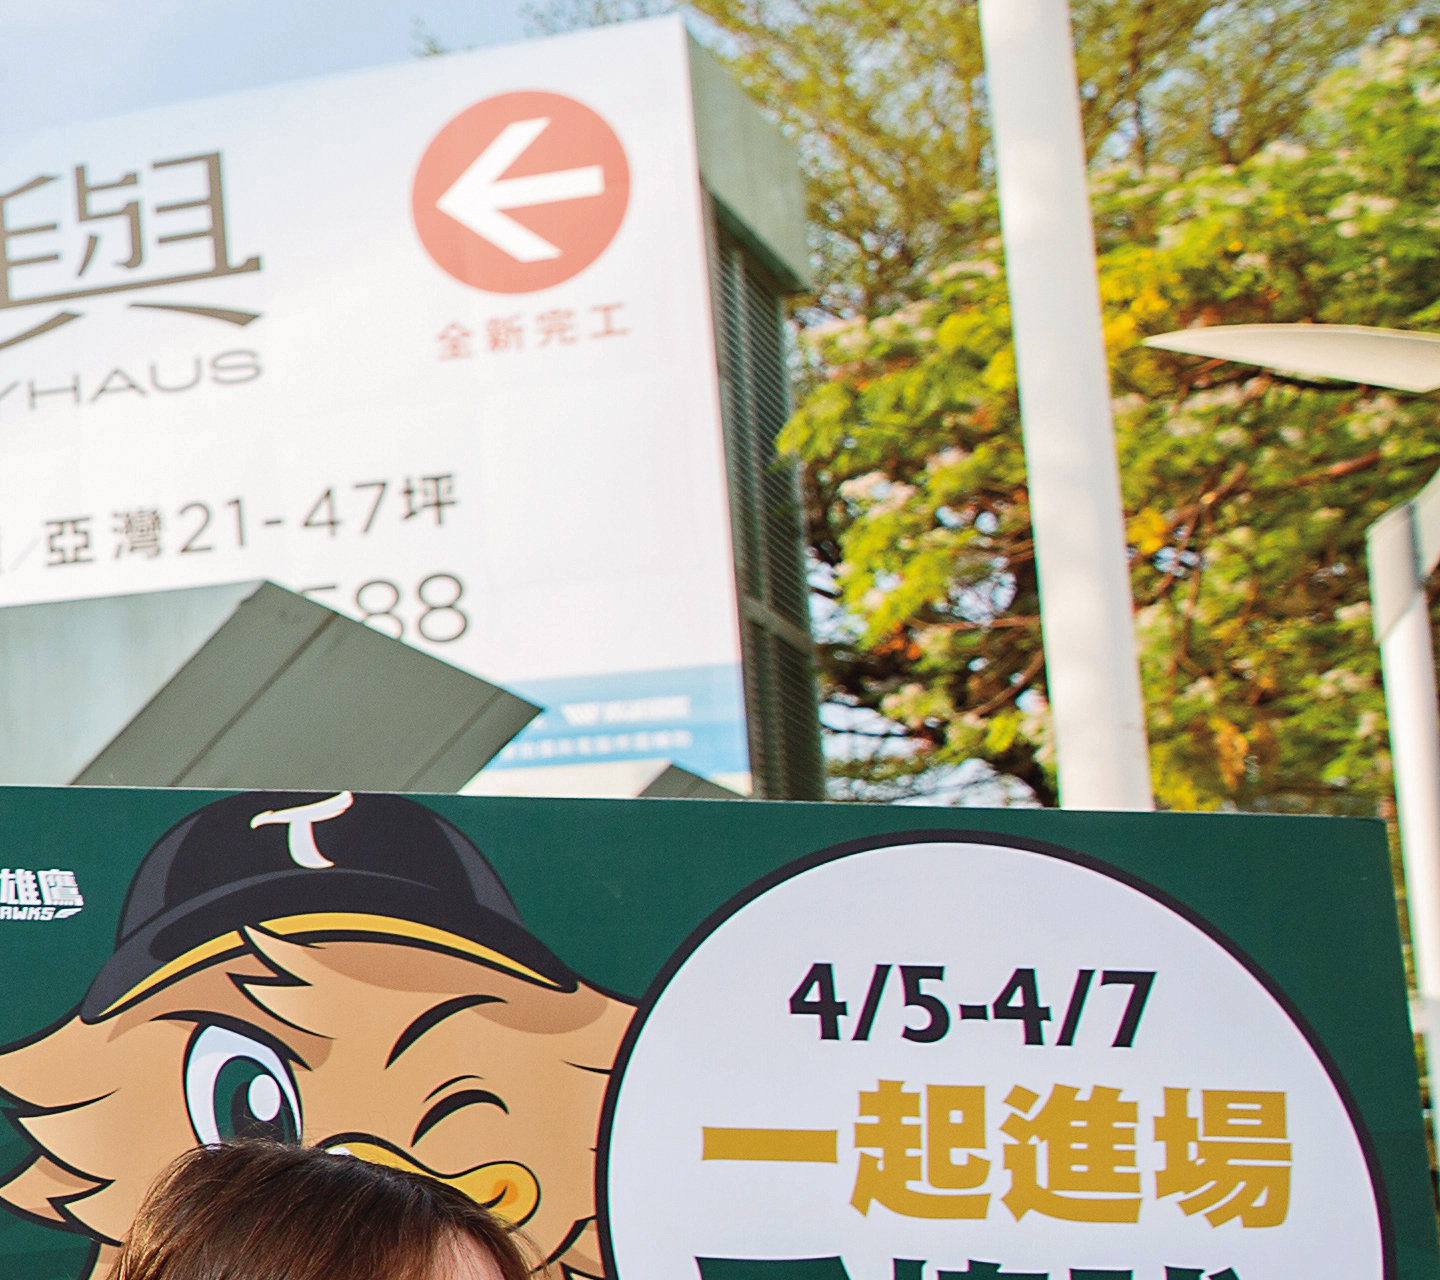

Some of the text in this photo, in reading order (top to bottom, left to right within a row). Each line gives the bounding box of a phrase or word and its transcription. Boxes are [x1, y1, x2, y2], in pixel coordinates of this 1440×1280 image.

[435, 302, 632, 362] 全新完工
[789, 960, 1158, 1050] 4/5-4/7
[701, 1079, 1295, 1230] 一起進場
